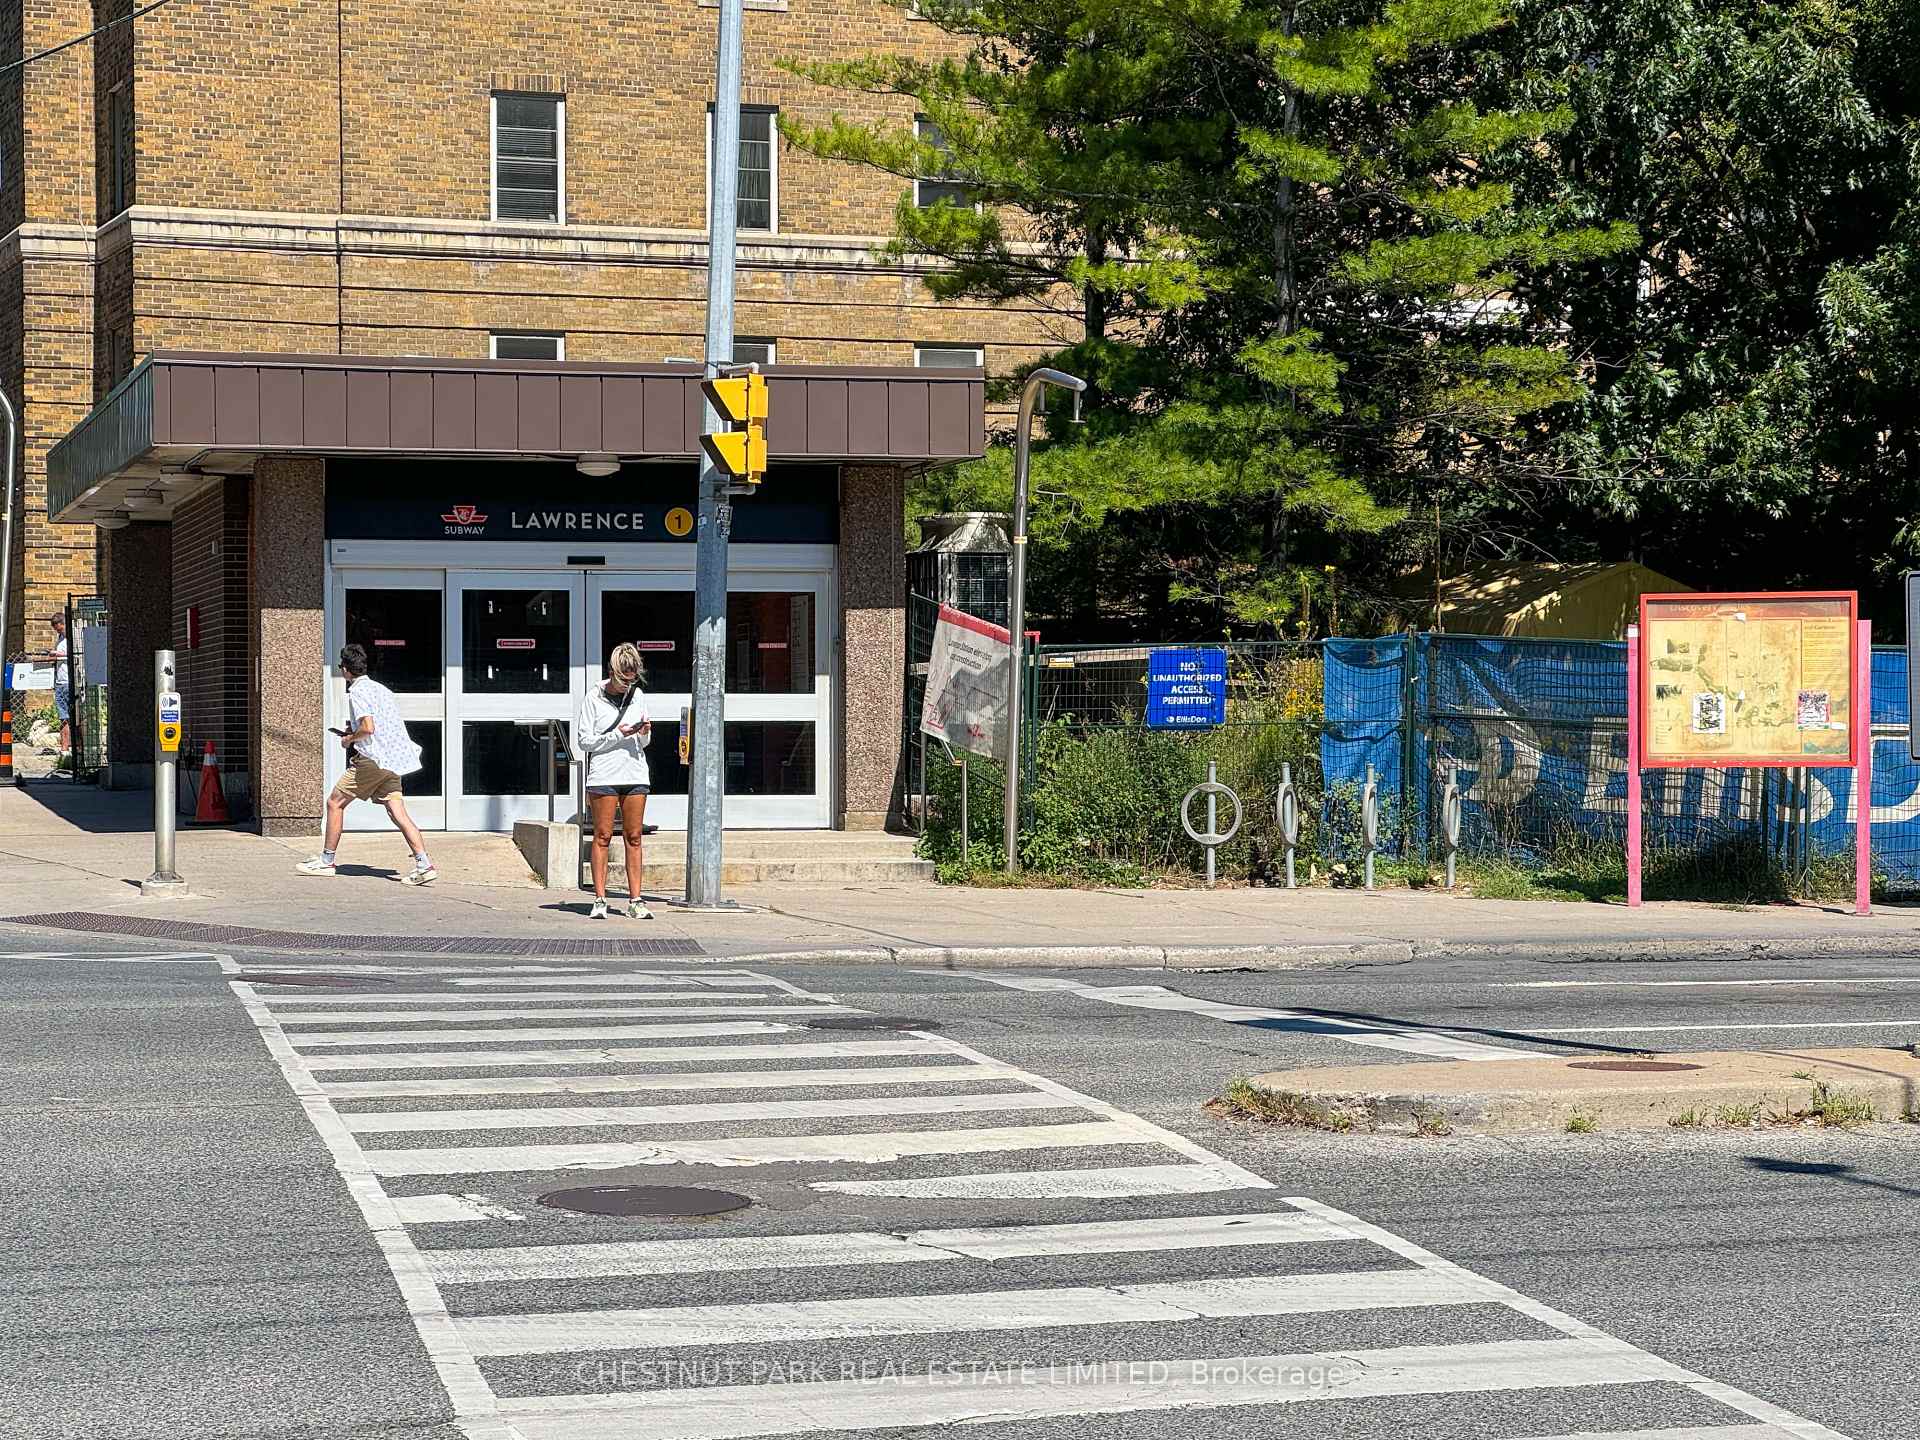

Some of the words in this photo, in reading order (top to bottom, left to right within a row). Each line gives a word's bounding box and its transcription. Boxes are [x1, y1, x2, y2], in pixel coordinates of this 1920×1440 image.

[511, 511, 644, 530] LAWRENCE
[444, 526, 485, 535] SUBWAY
[1180, 662, 1196, 671] NO
[1153, 674, 1222, 682] UNAUTHORIZED
[1171, 685, 1203, 694] ACCESS
